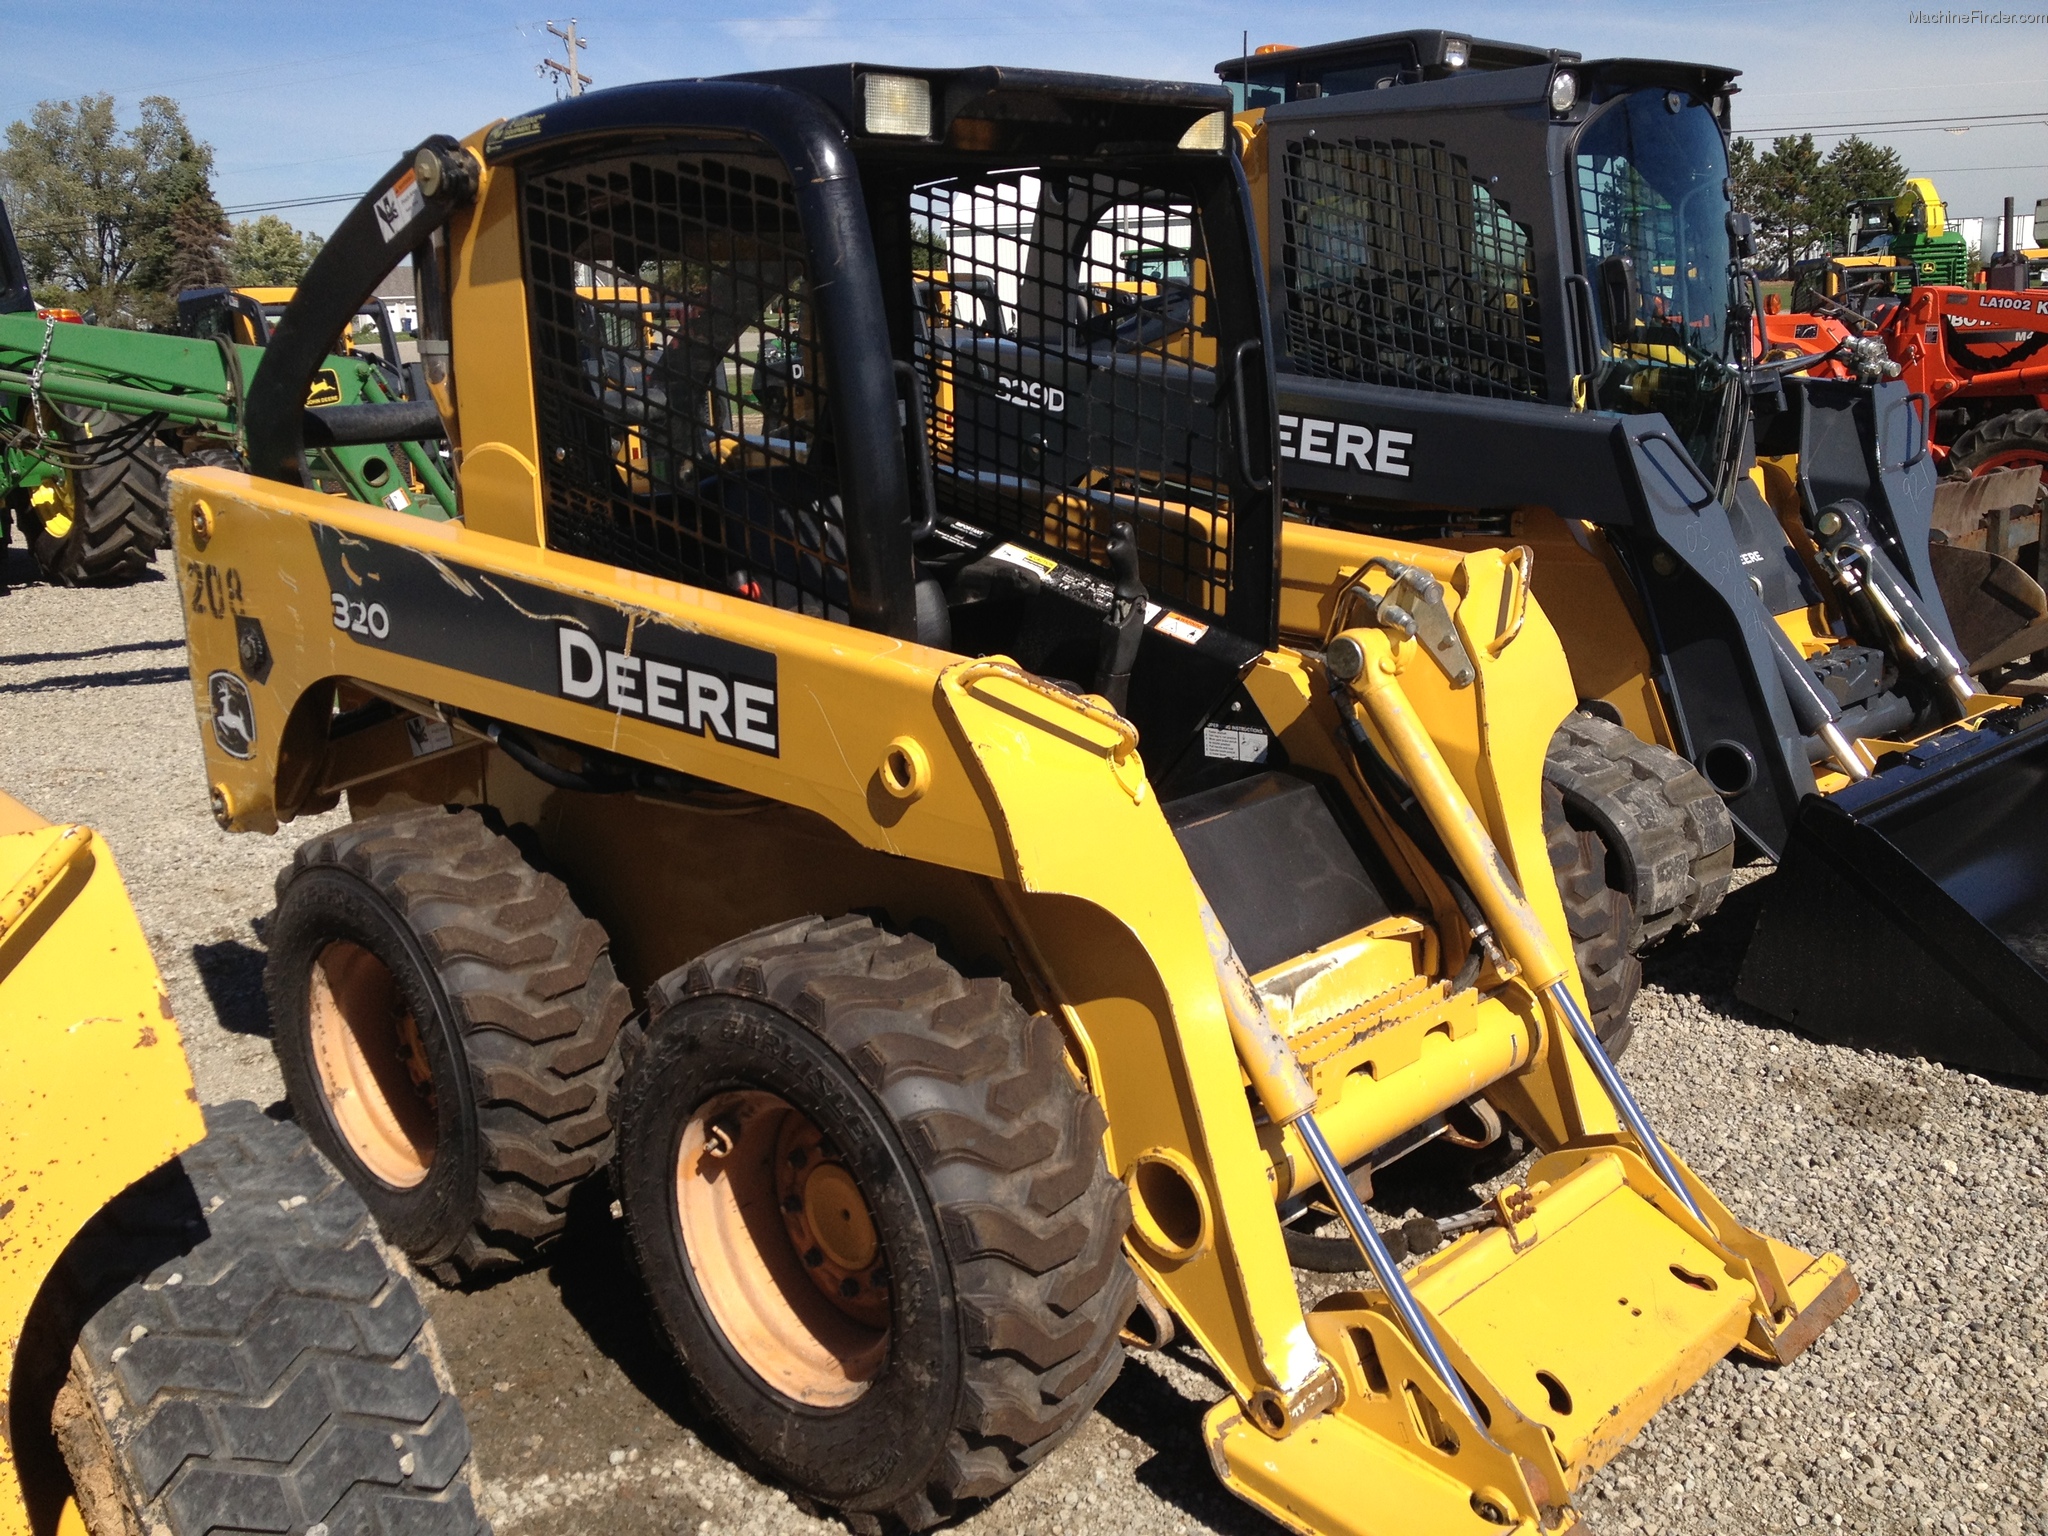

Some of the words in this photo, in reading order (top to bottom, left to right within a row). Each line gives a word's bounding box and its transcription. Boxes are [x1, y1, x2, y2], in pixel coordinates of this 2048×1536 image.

[1980, 296, 2031, 311] LA1002
[331, 592, 390, 639] 320
[559, 626, 776, 750] DEERE
